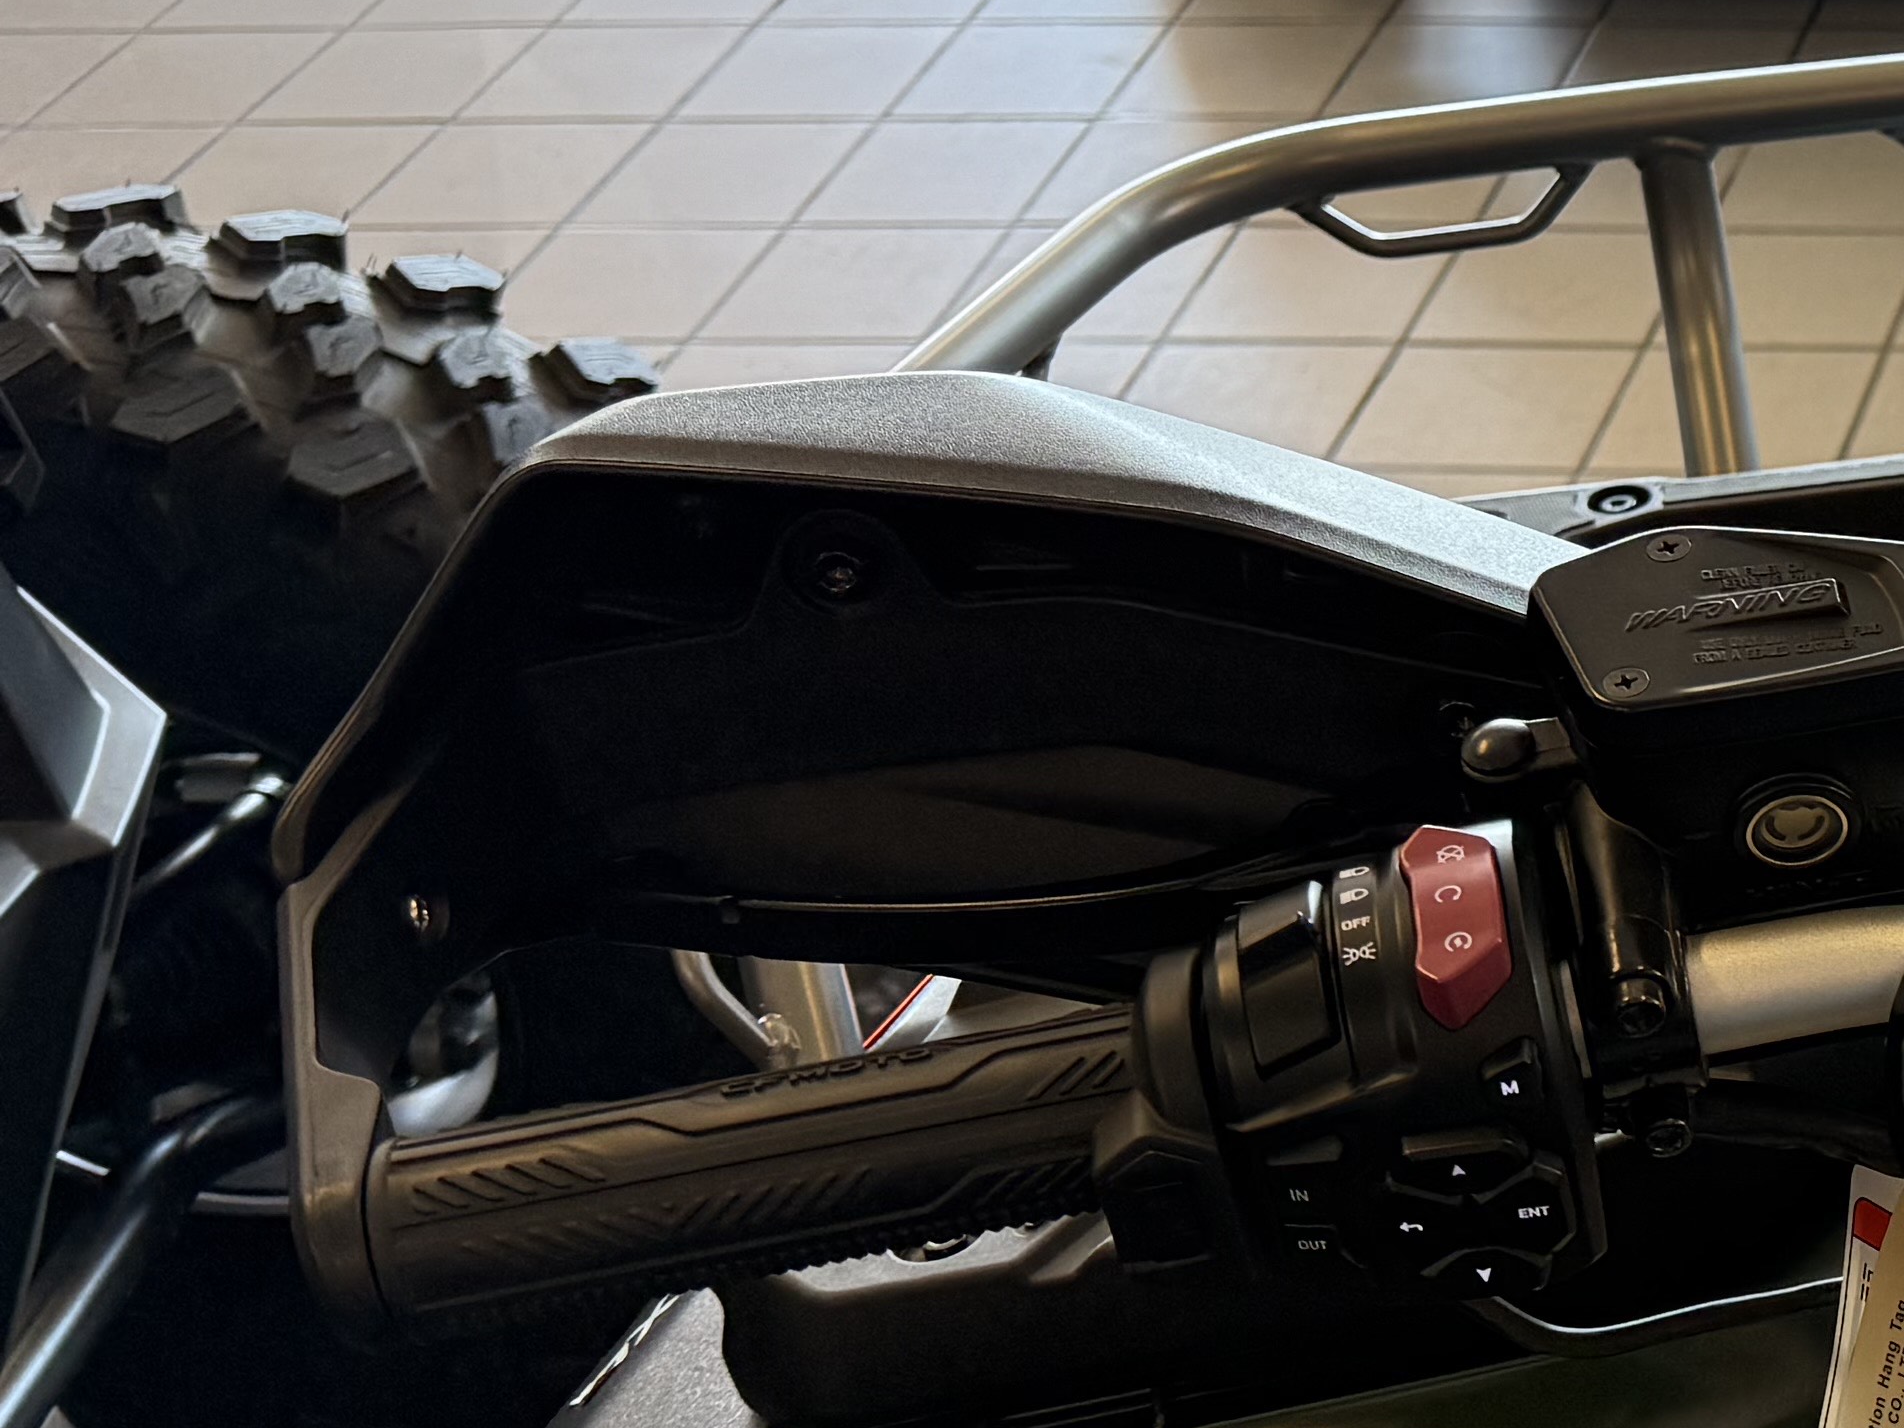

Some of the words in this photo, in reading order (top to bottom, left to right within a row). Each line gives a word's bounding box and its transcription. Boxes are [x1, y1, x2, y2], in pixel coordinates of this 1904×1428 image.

[1340, 915, 1371, 932] OFF
[1500, 1080, 1520, 1096] M
[1289, 1188, 1309, 1203] IN
[1518, 1205, 1550, 1220] ENT
[1298, 1239, 1327, 1252] OUT
[1877, 1340, 1902, 1389] Hang
